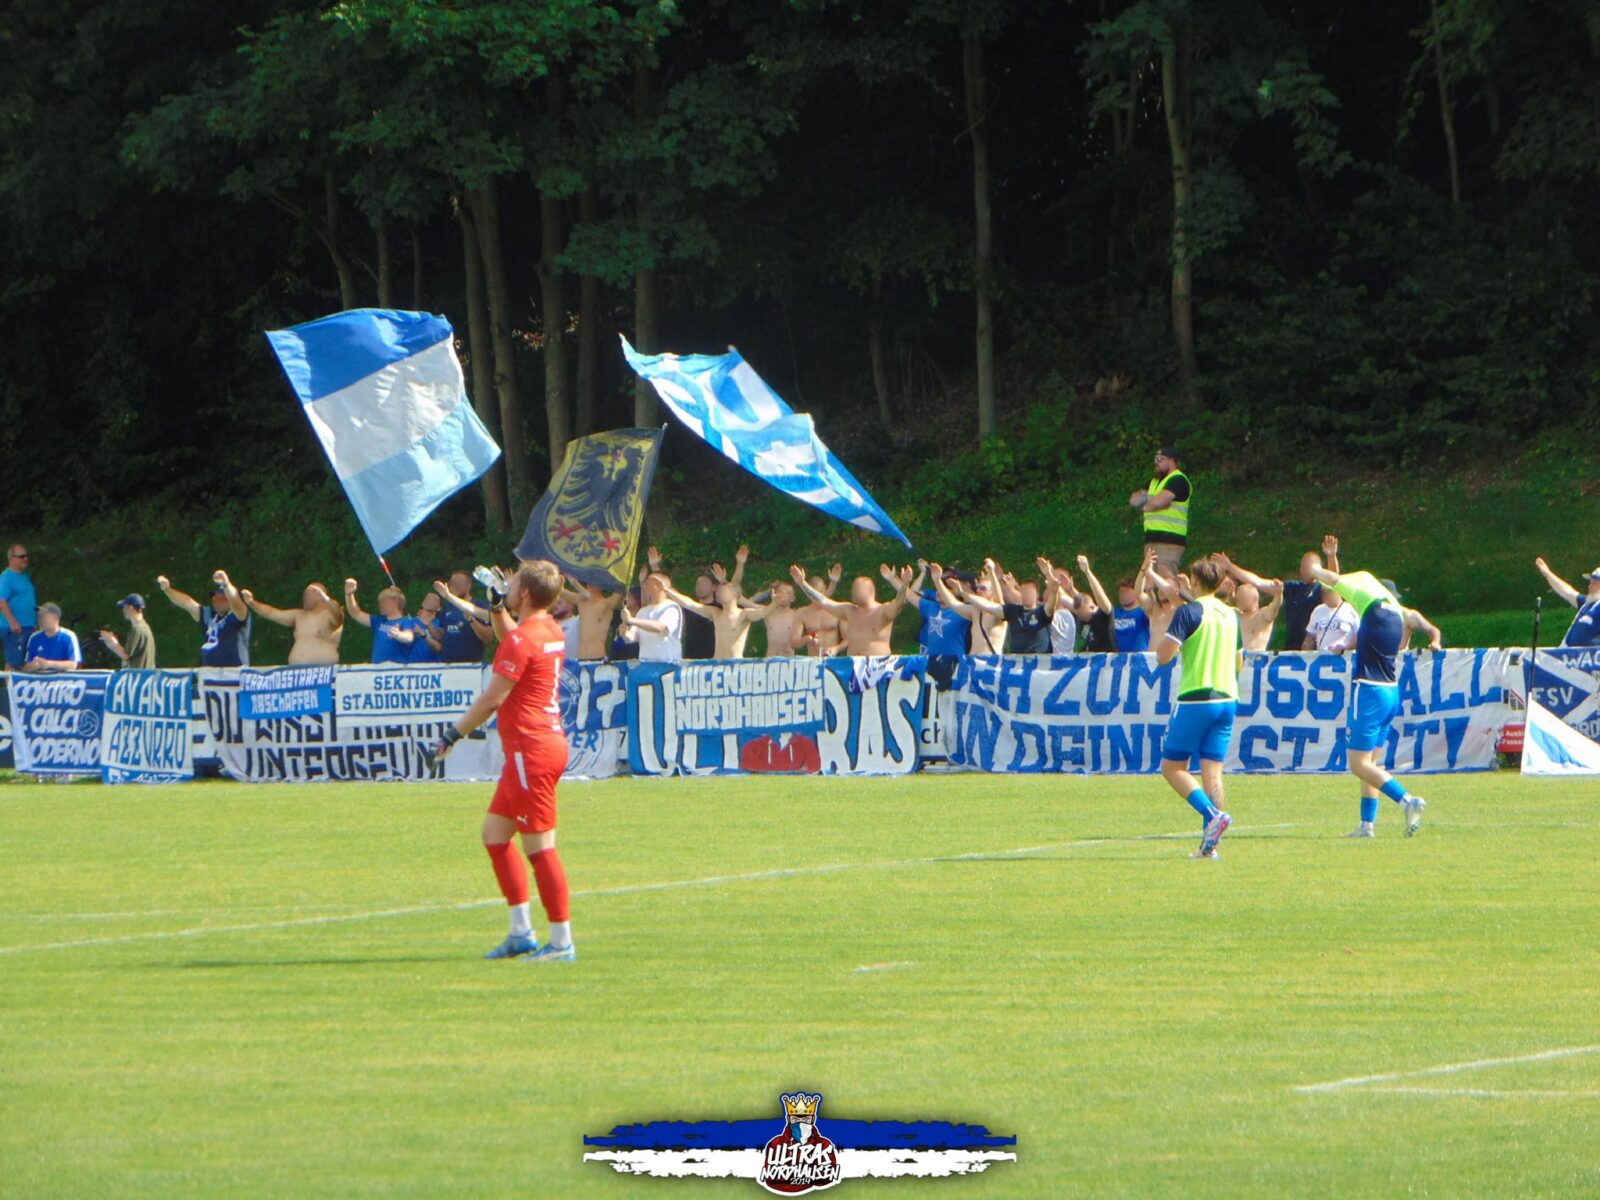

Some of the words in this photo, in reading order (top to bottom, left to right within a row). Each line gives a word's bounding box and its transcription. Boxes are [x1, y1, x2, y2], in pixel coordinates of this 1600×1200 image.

[13, 680, 86, 705] CONTRO
[113, 672, 189, 716] AVANTI
[374, 673, 441, 690] SEKTION
[674, 657, 823, 698] JUGENDBANDE
[1043, 653, 1177, 715] ZUM
[342, 690, 473, 710] STADIONVERBOT
[675, 687, 823, 730] NORDHAUSEN
[1532, 687, 1574, 707] FSV
[27, 736, 101, 766] ODERNO
[109, 719, 187, 769] AZZURRO
